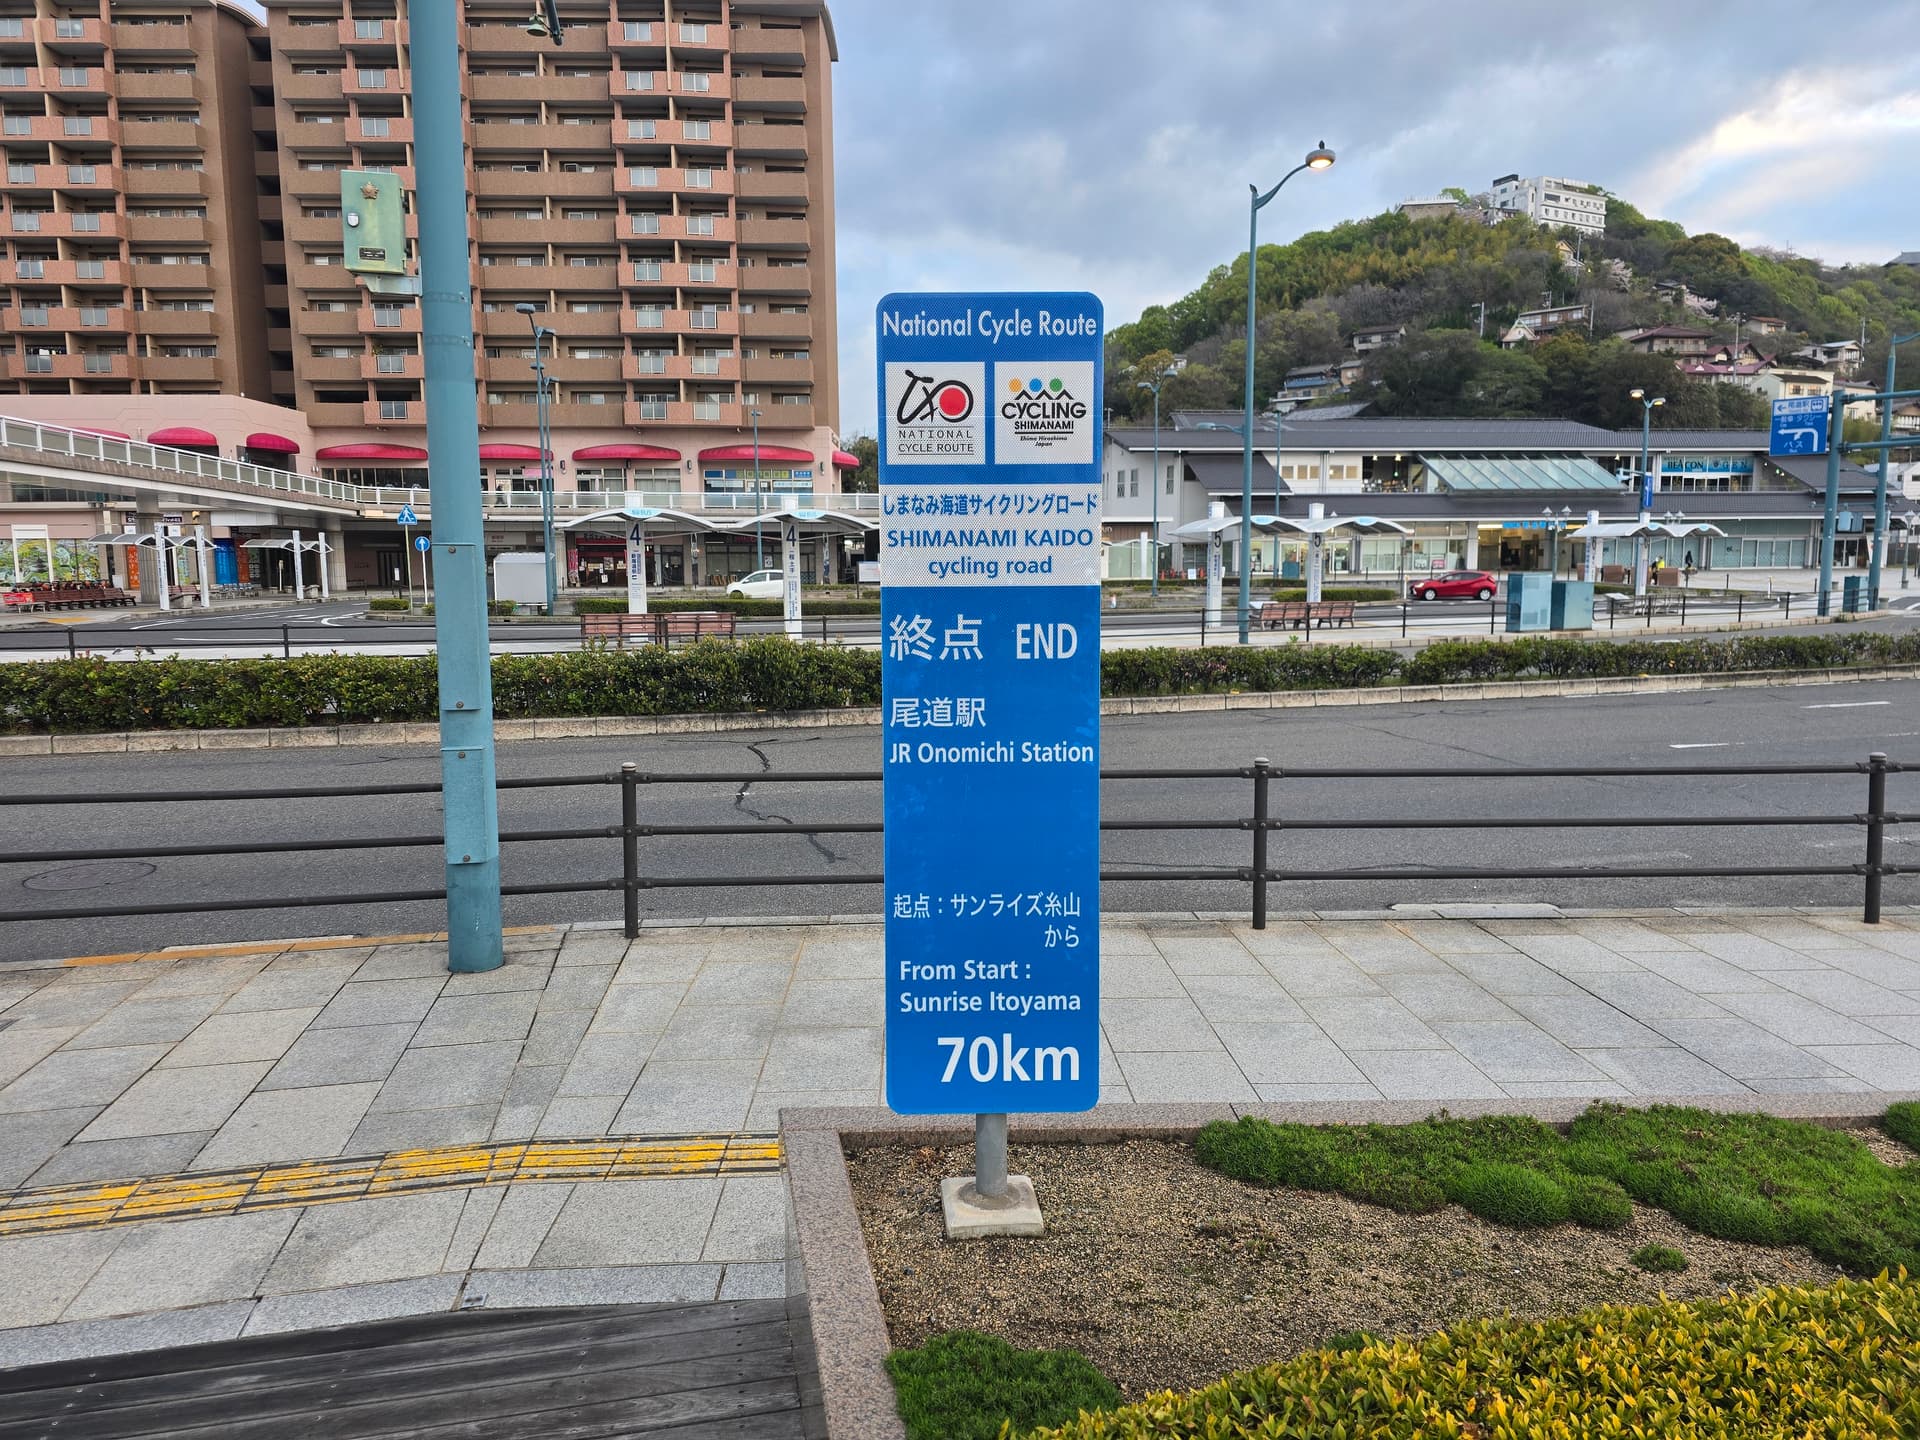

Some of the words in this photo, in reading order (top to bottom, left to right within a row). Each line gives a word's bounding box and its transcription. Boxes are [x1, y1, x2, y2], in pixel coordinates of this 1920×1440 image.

[882, 308, 972, 337] National
[978, 308, 1032, 345] Cycle
[1039, 310, 1097, 336] Route
[1001, 402, 1087, 420] CYCLING
[898, 429, 973, 439] NATIONAL
[1014, 420, 1074, 430] SHIMANAMI
[898, 443, 933, 453] CYCLE
[937, 443, 974, 453] ROUTE
[1667, 459, 1704, 469] BEACON
[883, 493, 1098, 516] しまなみ海道サイクリングロード
[629, 523, 641, 546] 4
[786, 525, 797, 547] 4
[887, 529, 1017, 547] SHIMANAMI
[1024, 529, 1094, 547] KAIDO
[928, 556, 999, 578] cycling
[1006, 556, 1053, 574] road
[889, 614, 984, 661] 終点
[1016, 623, 1078, 660] END
[889, 697, 986, 728] 尾道駅
[889, 743, 912, 763] JR
[917, 741, 1014, 763] Onomichi
[1021, 741, 1094, 763] Station
[1044, 925, 1080, 948] から
[900, 960, 956, 980] From
[964, 959, 1019, 980] Start
[900, 991, 983, 1012] Sunrise
[990, 991, 1081, 1016] Itoyama
[937, 1033, 1080, 1083] 70km
